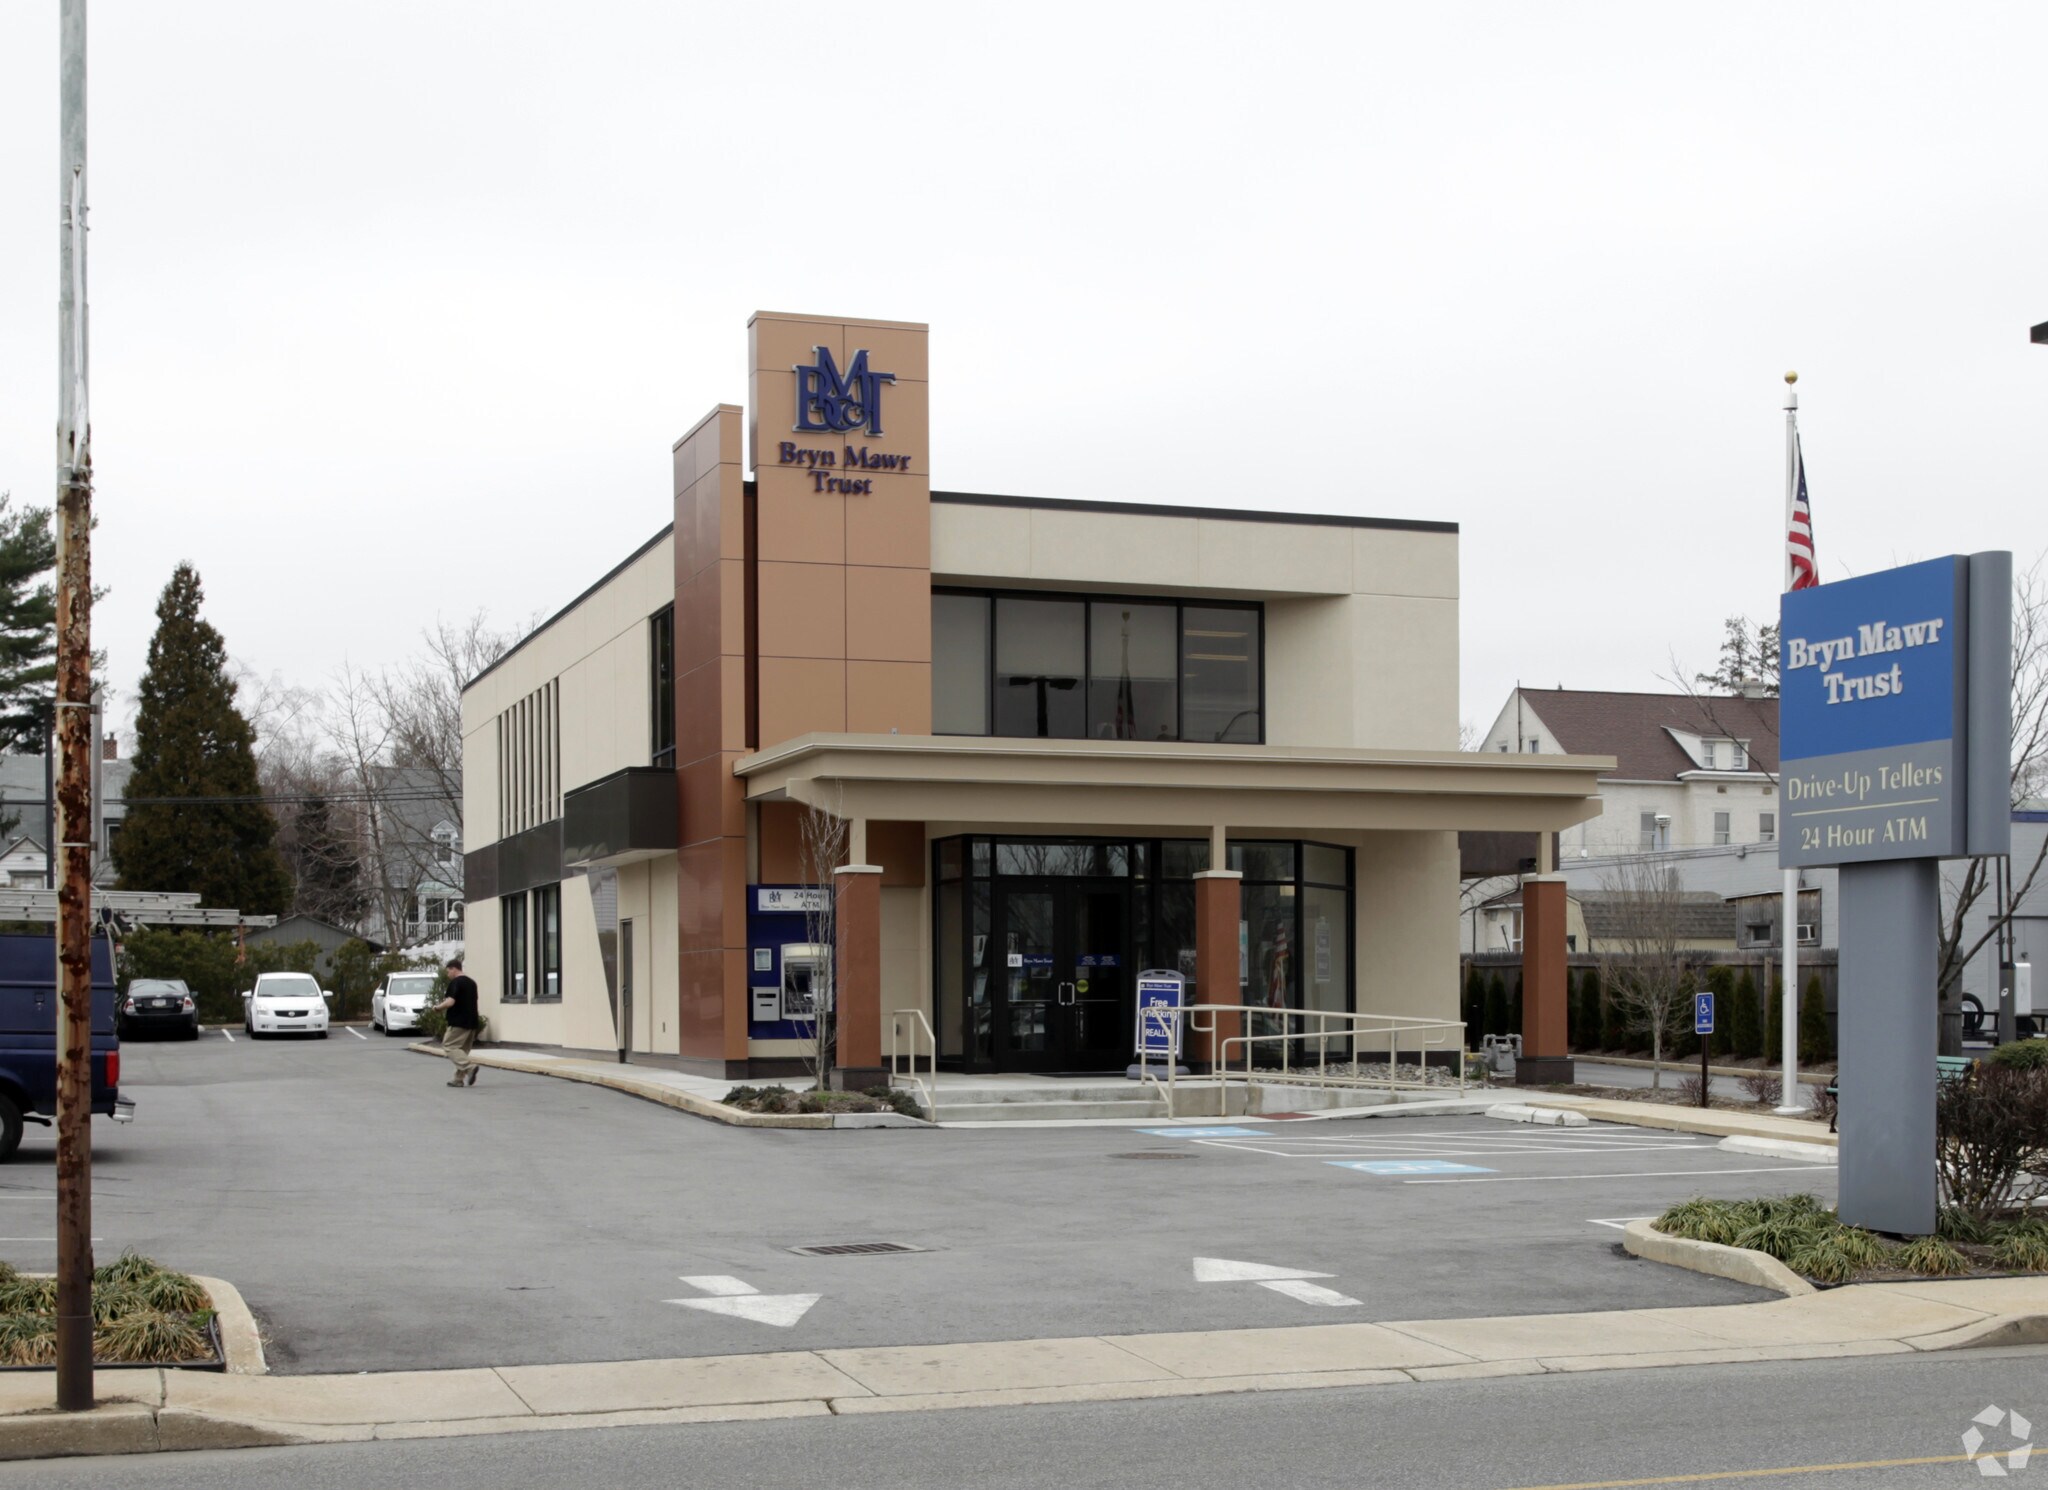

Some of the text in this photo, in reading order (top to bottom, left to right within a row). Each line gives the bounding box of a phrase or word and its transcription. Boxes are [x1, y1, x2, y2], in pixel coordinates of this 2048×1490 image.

[778, 441, 912, 471] Bryn Mawr
[808, 470, 873, 494] Trust
[1787, 617, 1943, 672] Bryn Mawr
[1823, 662, 1903, 704] Trust
[1788, 762, 1942, 800] Drive-Up Tellers
[1801, 816, 1927, 850] 24 Hour ATM
[793, 891, 803, 899] 24
[801, 901, 820, 909] ATM
[1150, 996, 1168, 1007] Free
